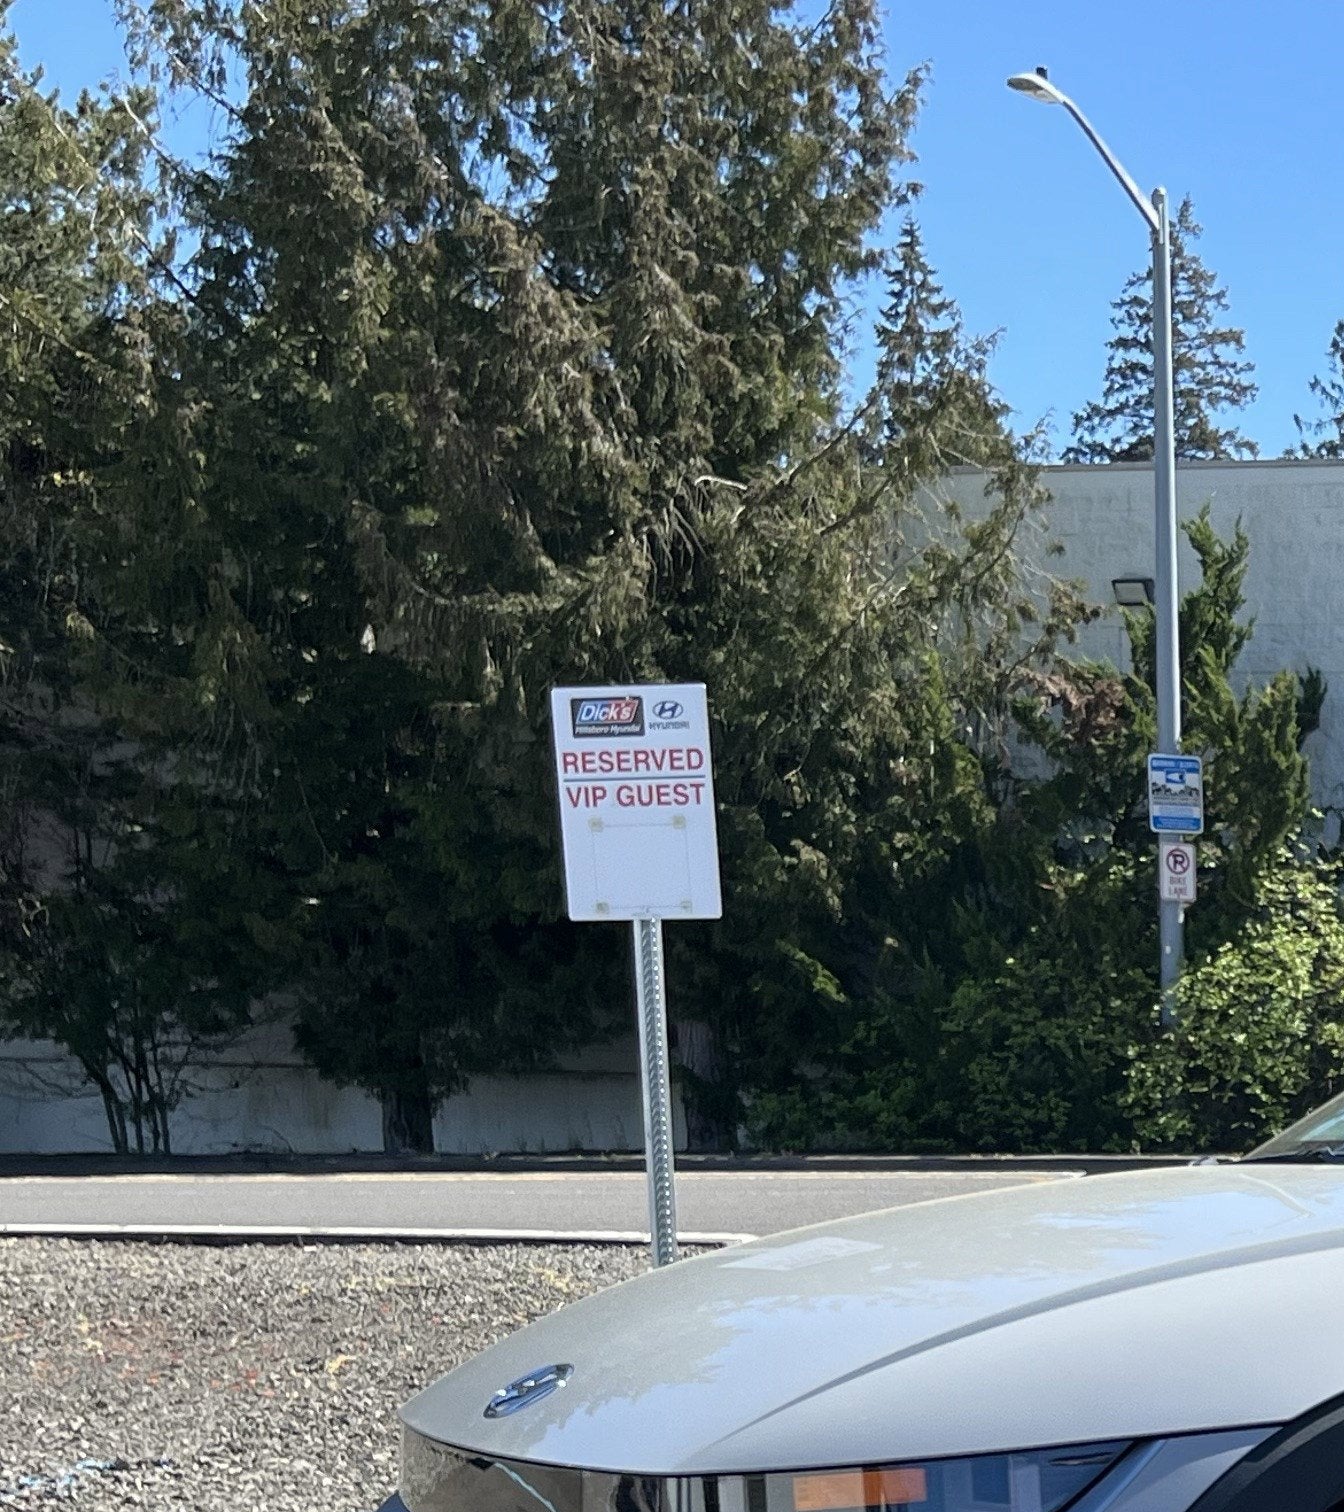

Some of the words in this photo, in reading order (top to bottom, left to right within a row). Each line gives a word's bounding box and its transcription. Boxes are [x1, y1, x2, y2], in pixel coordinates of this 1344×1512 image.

[580, 702, 633, 723] Dick's
[561, 748, 704, 774] RESERVED
[565, 786, 608, 809] VIP
[616, 783, 706, 808] GUEST
